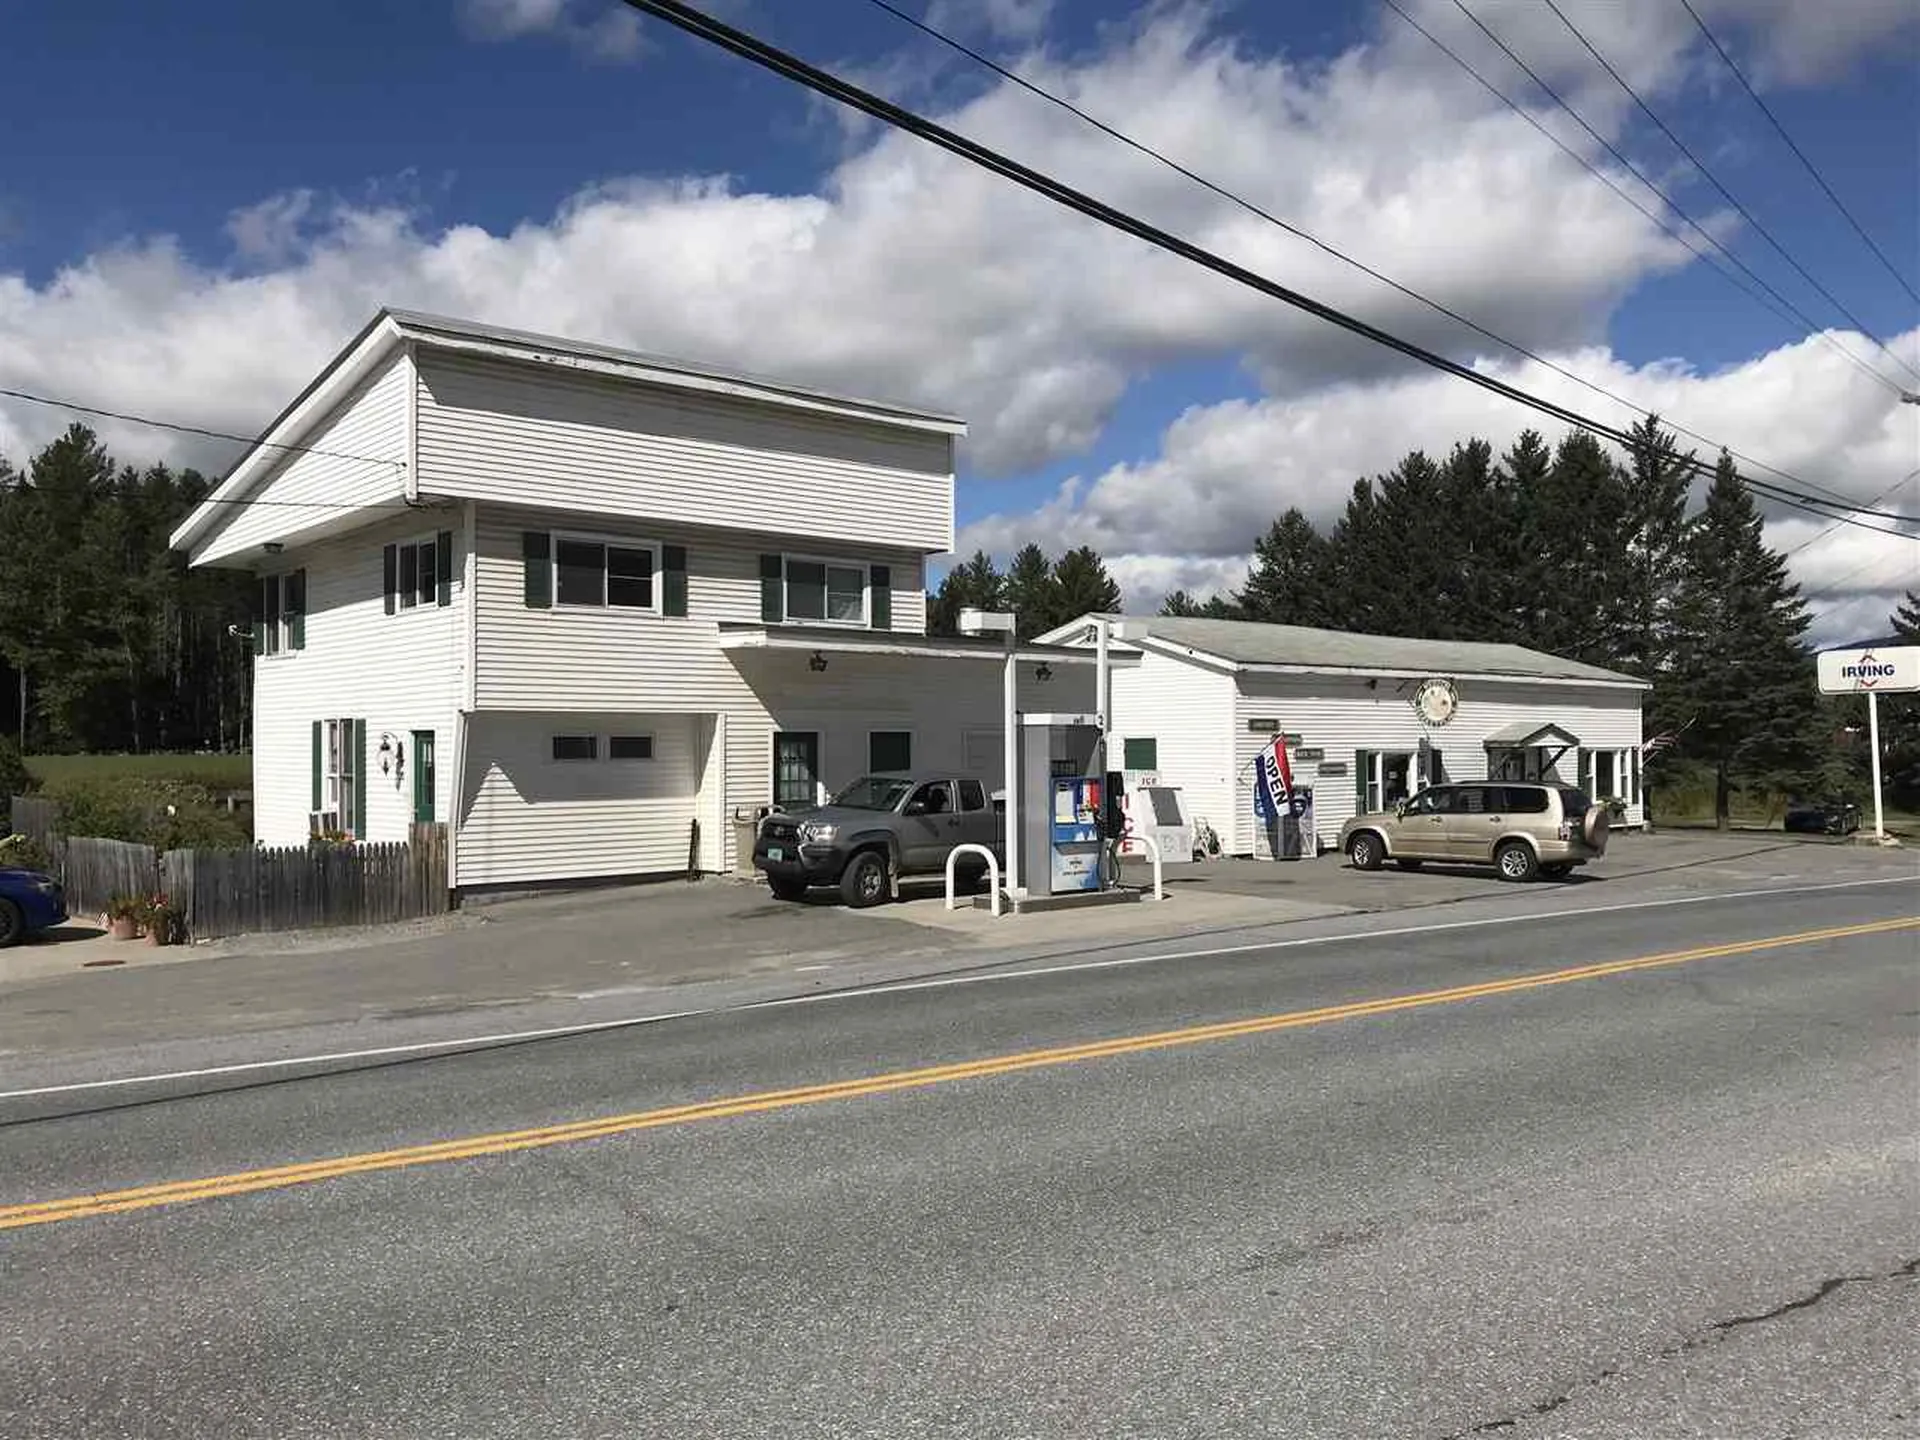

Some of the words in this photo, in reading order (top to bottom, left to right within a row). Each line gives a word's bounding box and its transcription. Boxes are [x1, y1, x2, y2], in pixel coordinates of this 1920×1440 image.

[1842, 664, 1895, 678] IRVING
[1142, 777, 1157, 786] ICE
[1265, 755, 1289, 806] OPEN
